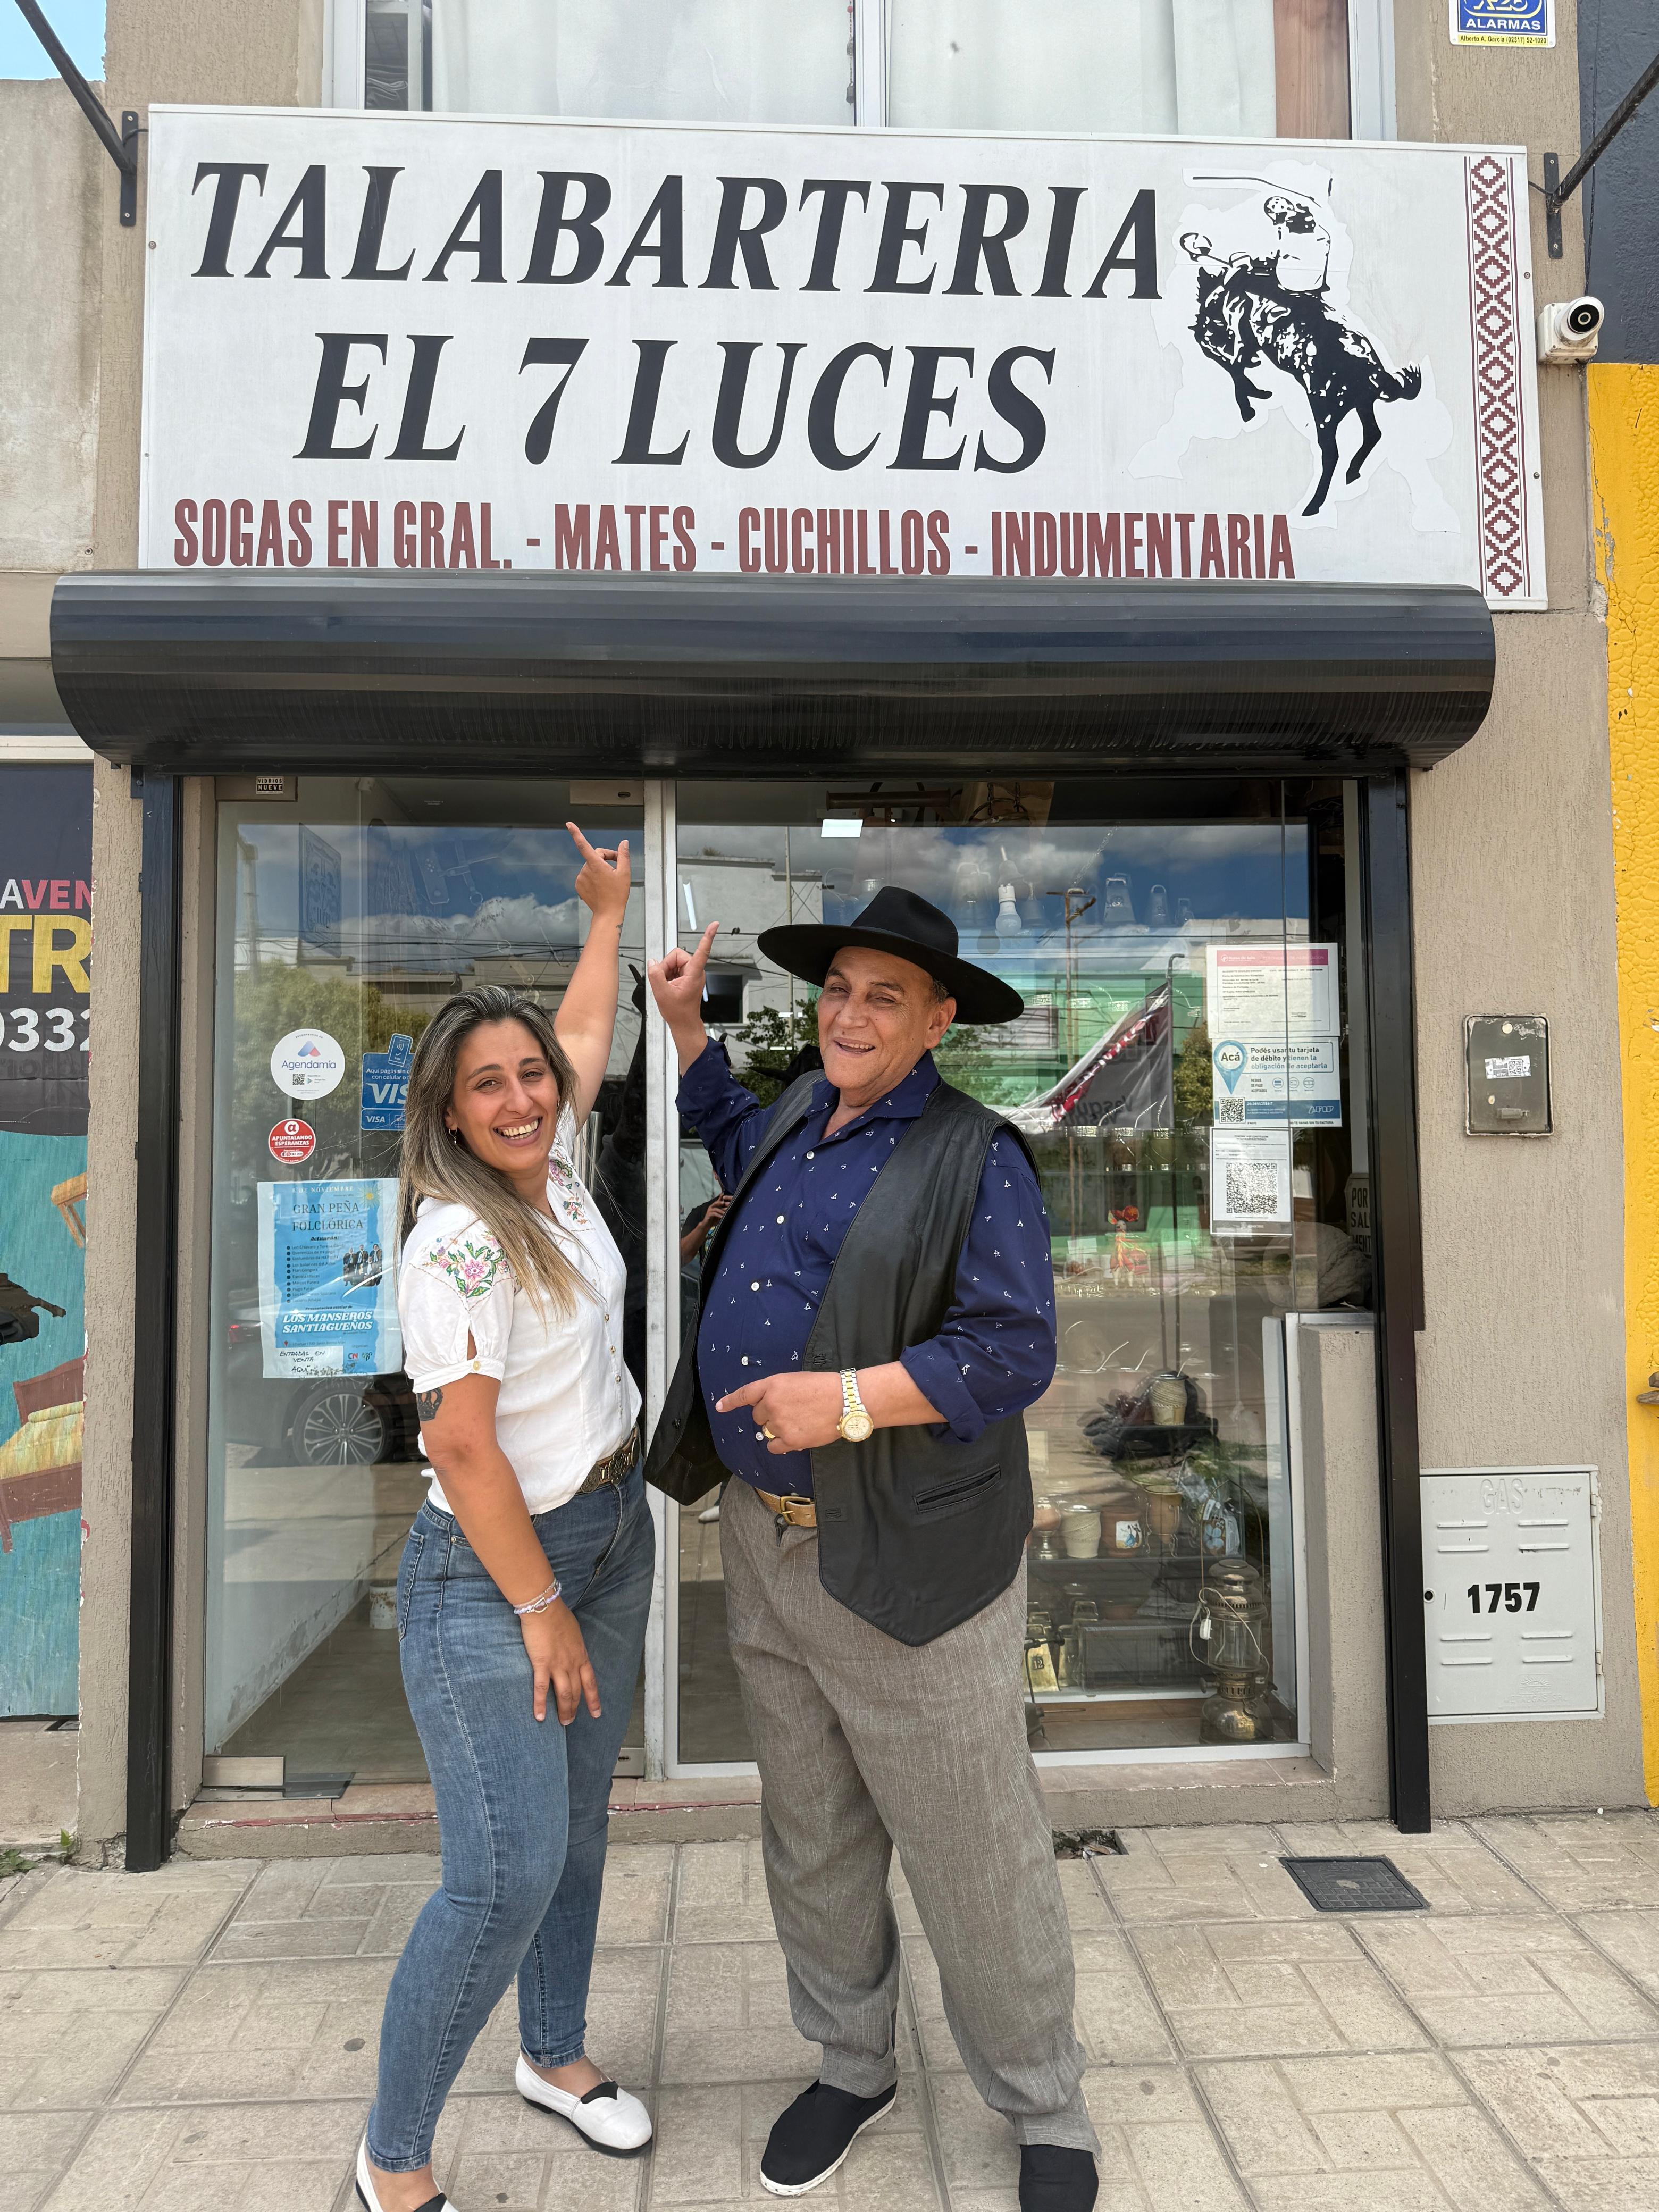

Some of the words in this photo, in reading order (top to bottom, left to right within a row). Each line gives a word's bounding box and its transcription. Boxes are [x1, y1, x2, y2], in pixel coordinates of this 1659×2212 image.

[1466, 18, 1541, 30] ALARMAS
[191, 162, 1162, 300] TALABARTERIA
[293, 332, 466, 461] EL
[518, 337, 590, 465] 7
[611, 339, 1057, 474] LUCES
[174, 498, 312, 567] SOGAS
[328, 500, 379, 567] EN
[393, 500, 512, 569] GRAL.
[555, 503, 696, 571] MATES
[739, 507, 950, 576] CUCHILLOS
[991, 510, 1296, 580] INDUMENTARIA
[281, 1060, 337, 1070] Agendamía
[1221, 1052, 1241, 1061] Acá
[365, 1083, 409, 1104] VIS
[1352, 1187, 1368, 1208] POR
[293, 1203, 325, 1214] GRAN
[329, 1200, 359, 1213] PEÑA
[292, 1218, 364, 1231] FOLCLÓRICA
[282, 1313, 306, 1323] LOS
[307, 1310, 373, 1322] MANSEROS
[282, 1320, 373, 1333] SANTIAGUEÑOS
[1481, 1478, 1524, 1515] GAS
[1468, 1582, 1540, 1614] 1757
